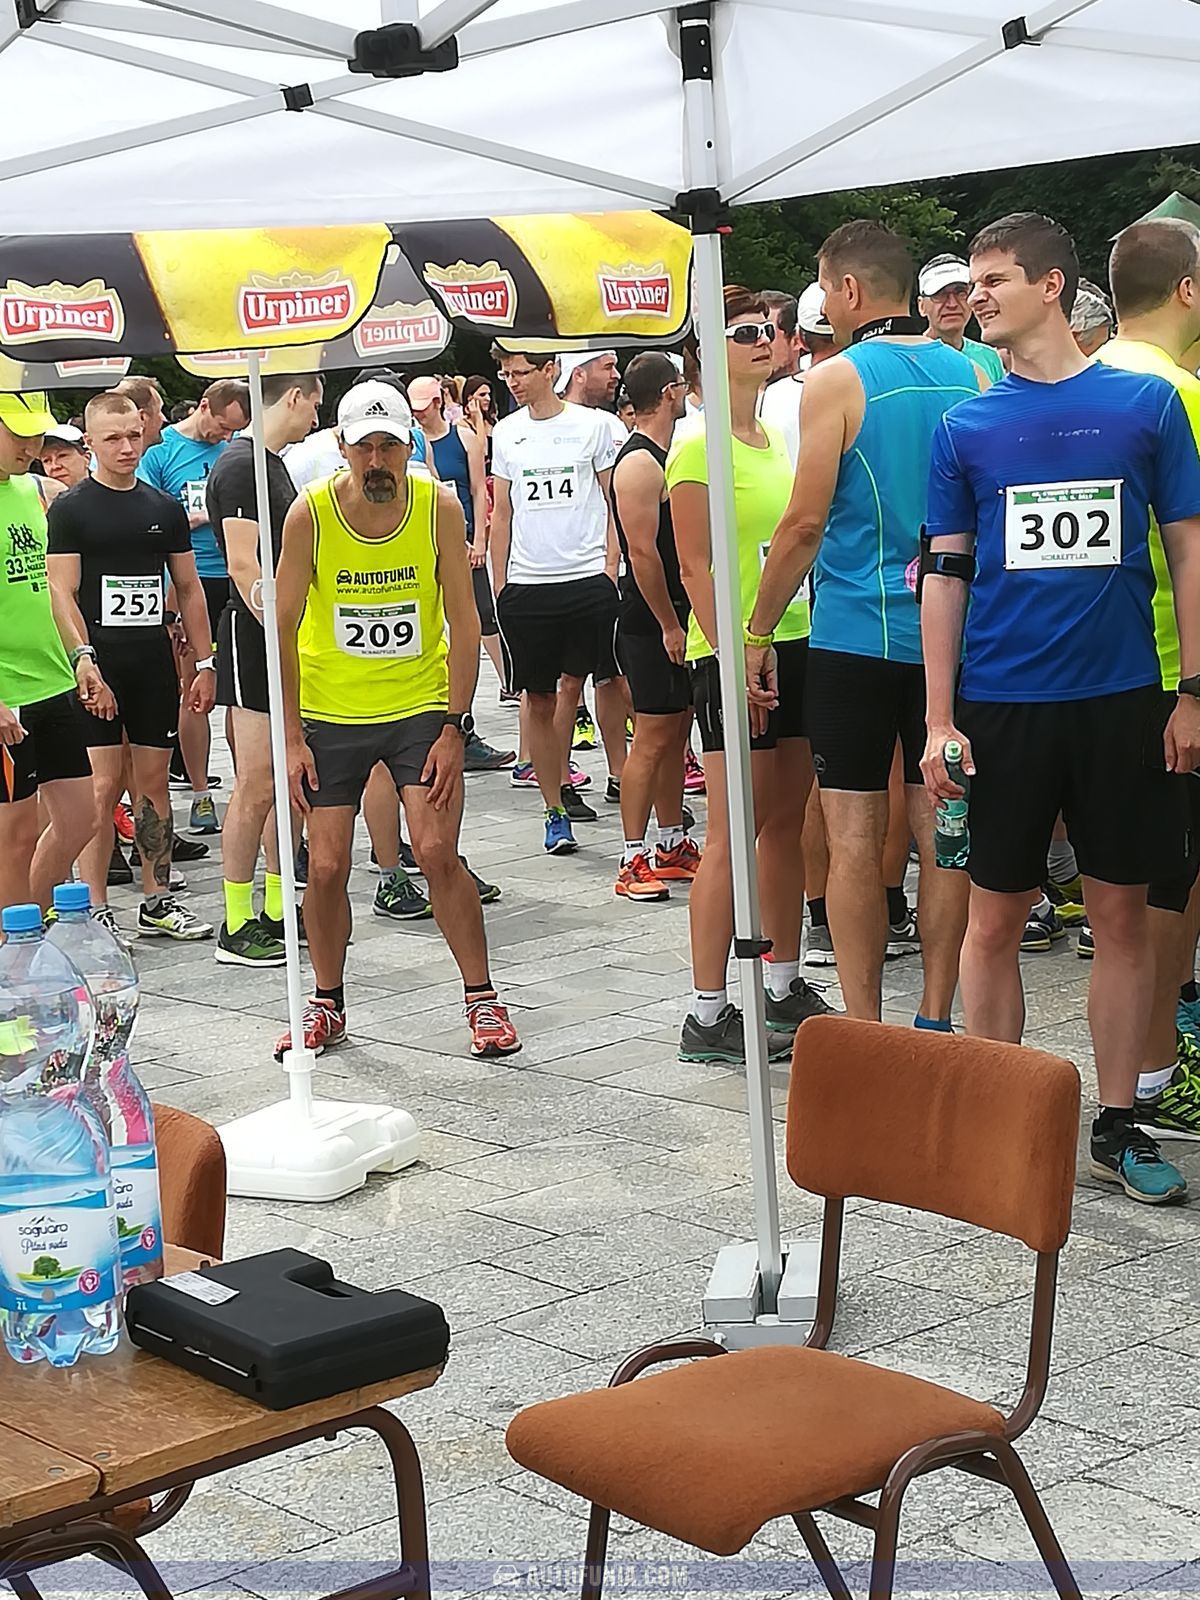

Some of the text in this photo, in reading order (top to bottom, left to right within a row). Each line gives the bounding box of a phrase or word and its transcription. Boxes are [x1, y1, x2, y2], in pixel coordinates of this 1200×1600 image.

[246, 291, 347, 325] Urpiner
[604, 279, 667, 310] Urpiner
[6, 301, 110, 330] Urpiner
[527, 479, 573, 501] 214
[1020, 510, 1110, 550] 302
[110, 593, 159, 616] 252
[345, 621, 413, 647] 209
[18, 1223, 68, 1238] saguaro
